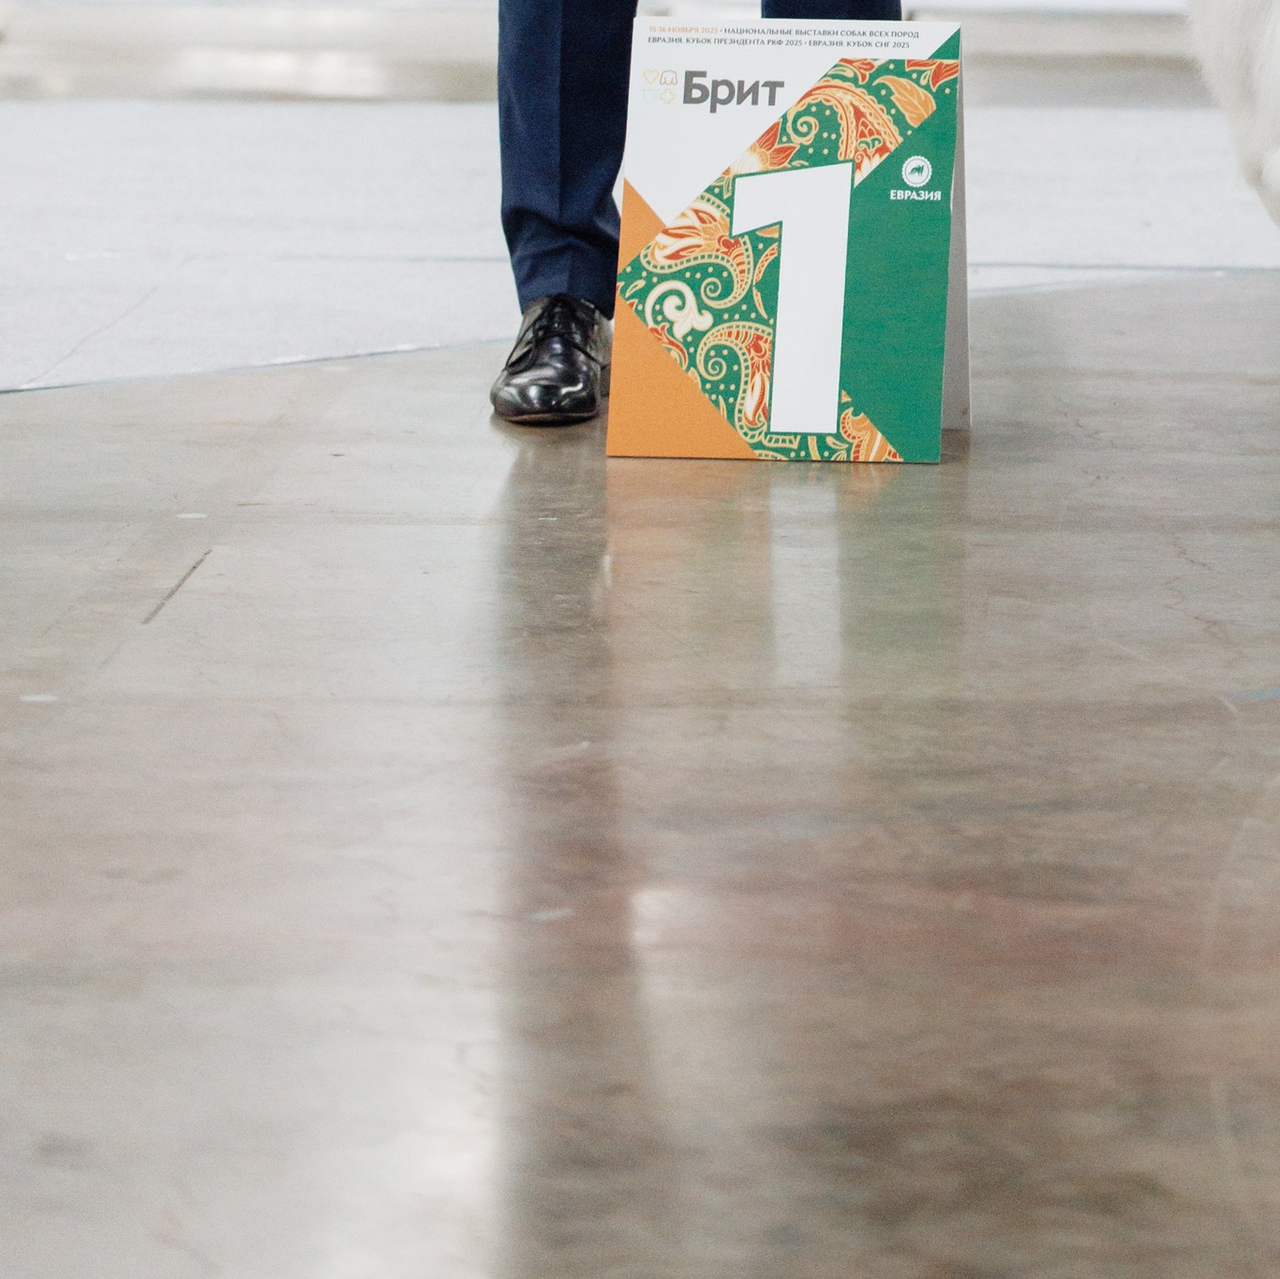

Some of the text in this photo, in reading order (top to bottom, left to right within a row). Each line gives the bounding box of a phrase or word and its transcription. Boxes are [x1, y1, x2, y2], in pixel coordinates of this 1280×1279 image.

[724, 27, 793, 35] НАЦИОНАЛЬНЫЕ
[795, 29, 839, 37] ВЫСТАВКИ
[840, 29, 868, 38] СОБАК
[869, 30, 890, 38] ВСЕХ
[891, 31, 920, 39] ПОРОД
[713, 38, 765, 46] ПРЕЗИДЕНТА
[785, 39, 803, 47] 2025
[892, 41, 910, 49] 2025
[682, 69, 785, 114] Брит
[890, 189, 942, 201] ЕВРАЗИЯ
[732, 161, 853, 434] 1
